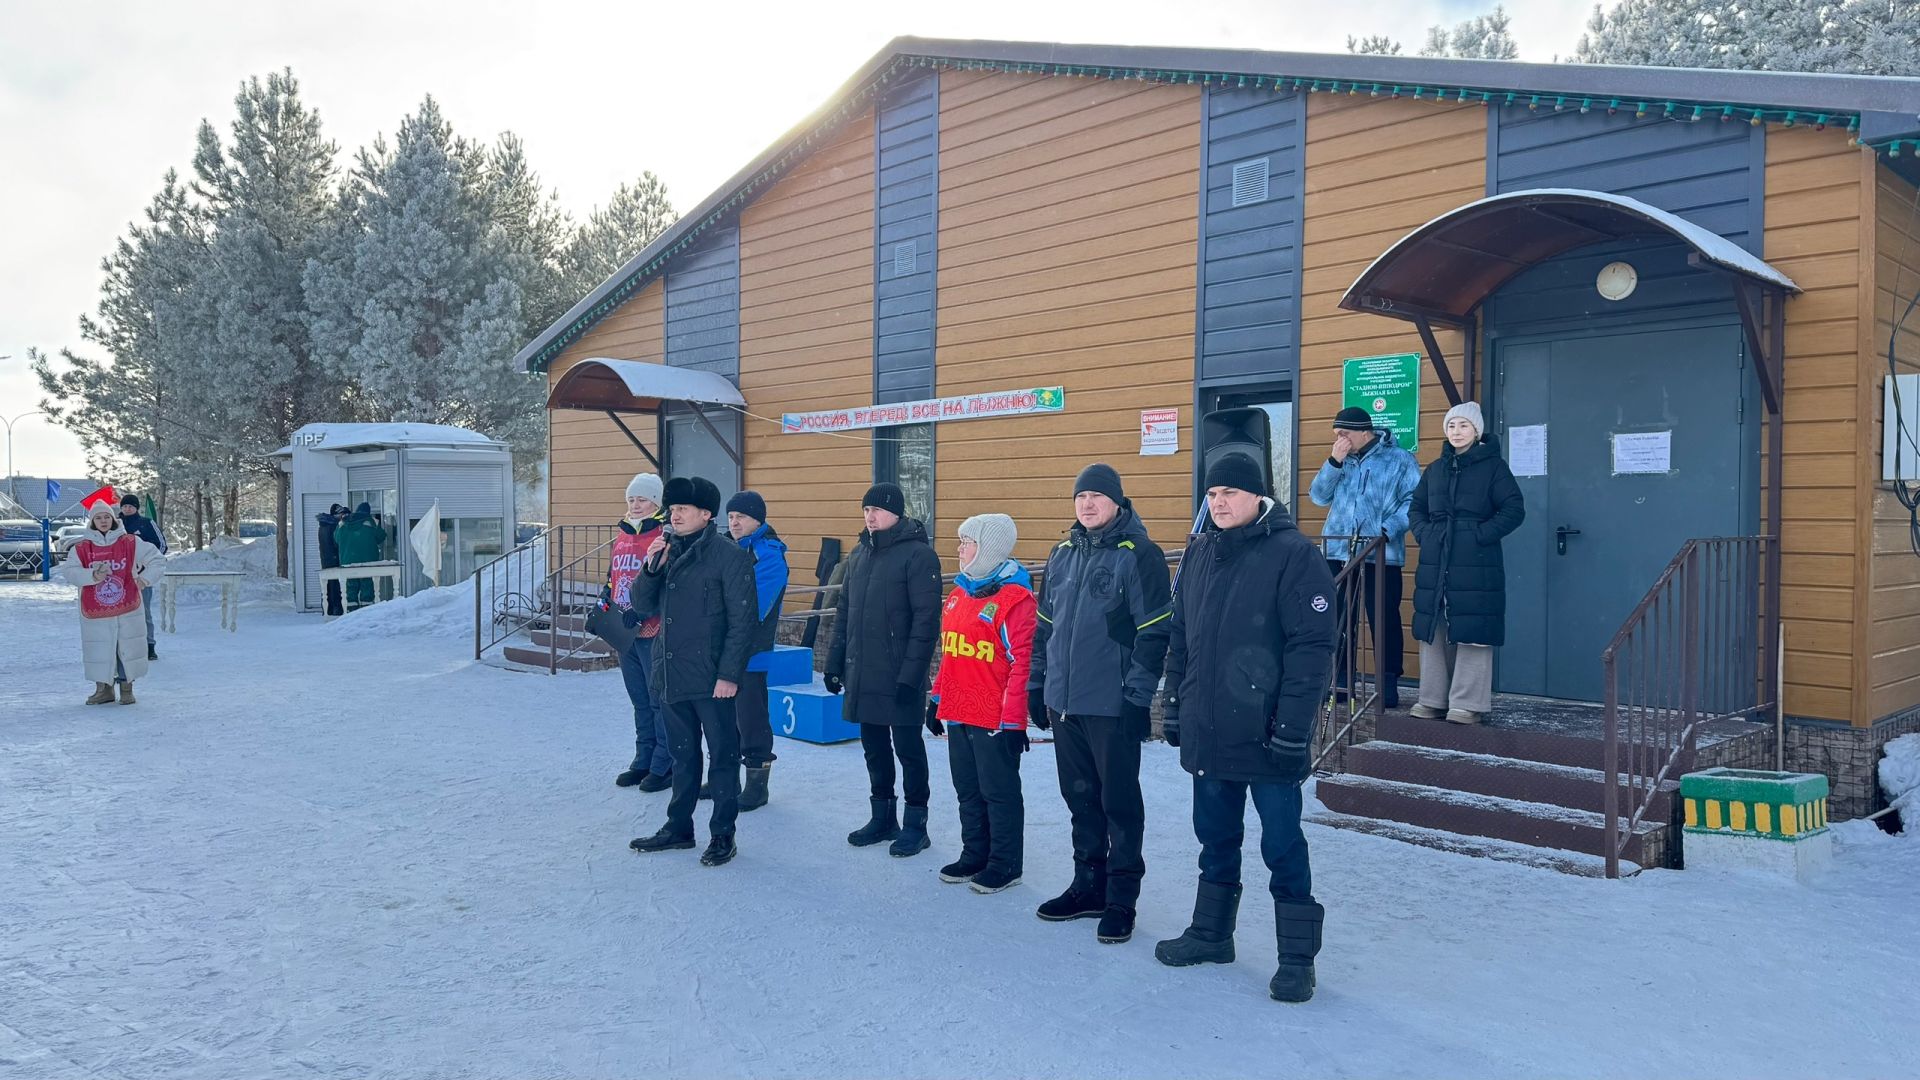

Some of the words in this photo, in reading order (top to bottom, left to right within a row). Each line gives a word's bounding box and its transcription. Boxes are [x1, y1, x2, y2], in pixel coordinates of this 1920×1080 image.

[911, 402, 940, 419] ВСЕ
[943, 400, 964, 416] НА
[612, 553, 648, 571] СУДЬ
[782, 696, 796, 735] 3
